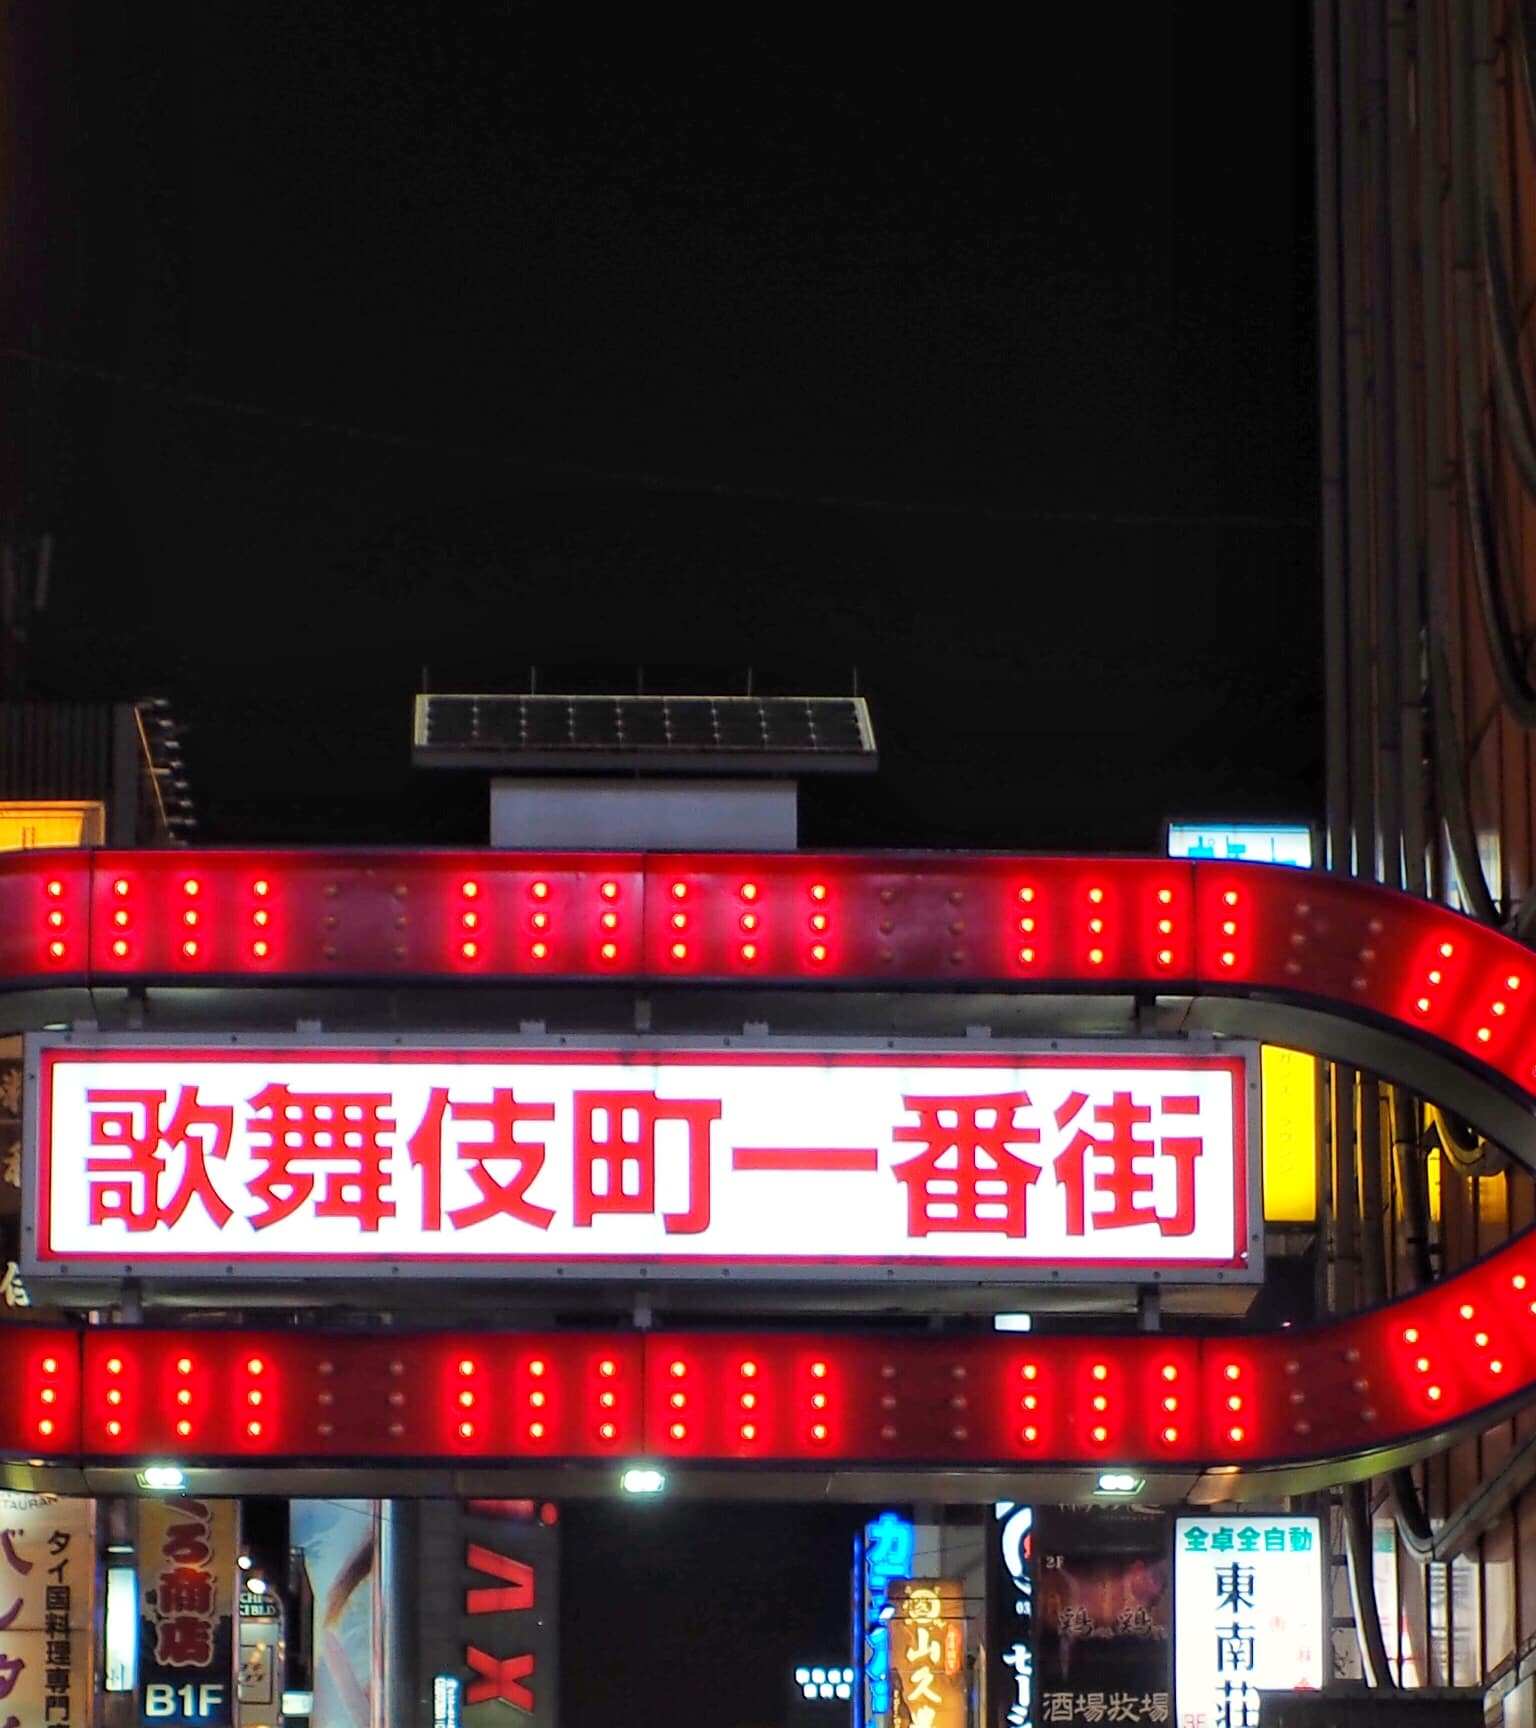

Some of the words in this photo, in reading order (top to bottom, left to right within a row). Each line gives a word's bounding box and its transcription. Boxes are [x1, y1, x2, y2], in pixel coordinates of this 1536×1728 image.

[85, 1083, 1202, 1241] 歌舞伎町一番街
[1184, 1526, 1312, 1552] 全卓全自動
[145, 1685, 224, 1717] B1F
